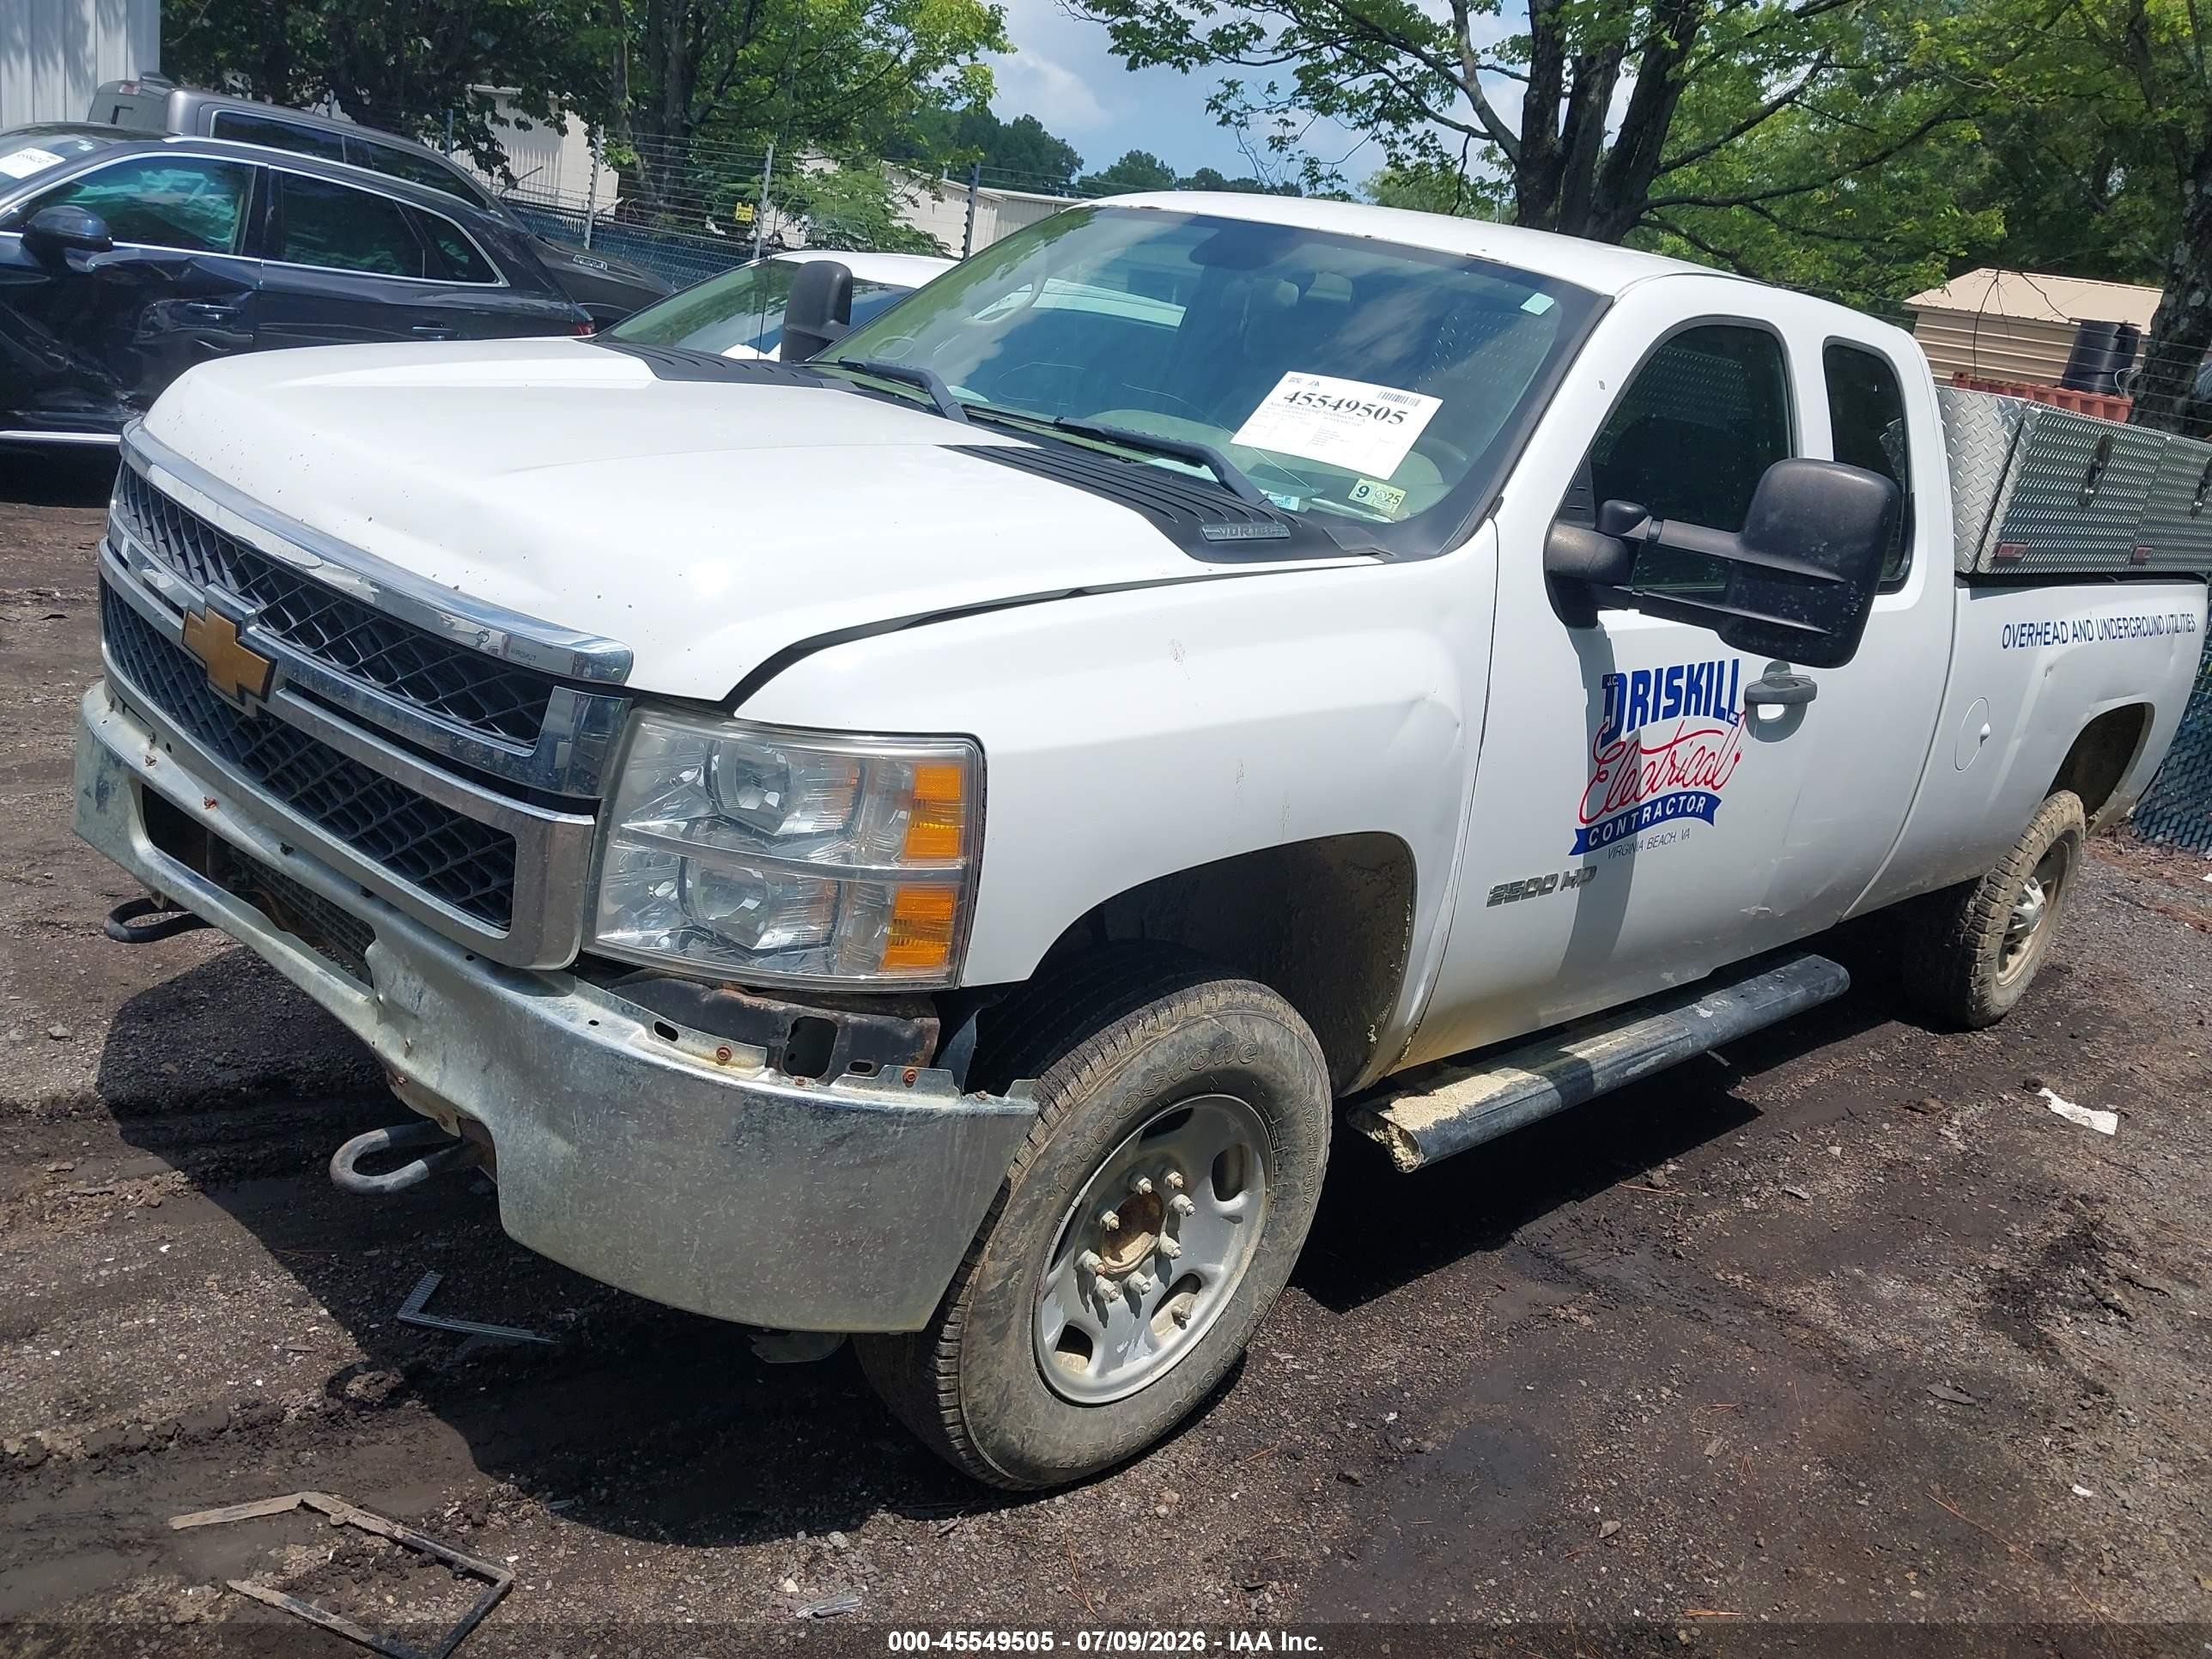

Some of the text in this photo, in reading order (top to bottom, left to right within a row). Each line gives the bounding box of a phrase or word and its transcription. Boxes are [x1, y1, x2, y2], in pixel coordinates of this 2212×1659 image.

[1284, 391, 1408, 425] 45549505
[1356, 485, 1370, 498] 9
[1385, 492, 1401, 505] 25
[2002, 612, 2196, 650] OVERHEAD AND UNDERGROUND UTILITIES
[1600, 658, 1740, 750] DRISKILL
[1579, 710, 1746, 825] Electrical
[1588, 795, 1707, 848] CONTRACTOR
[1607, 841, 1644, 860] VIRGINIA
[1680, 827, 1691, 842] VA
[1486, 865, 1598, 908] 2500 HD
